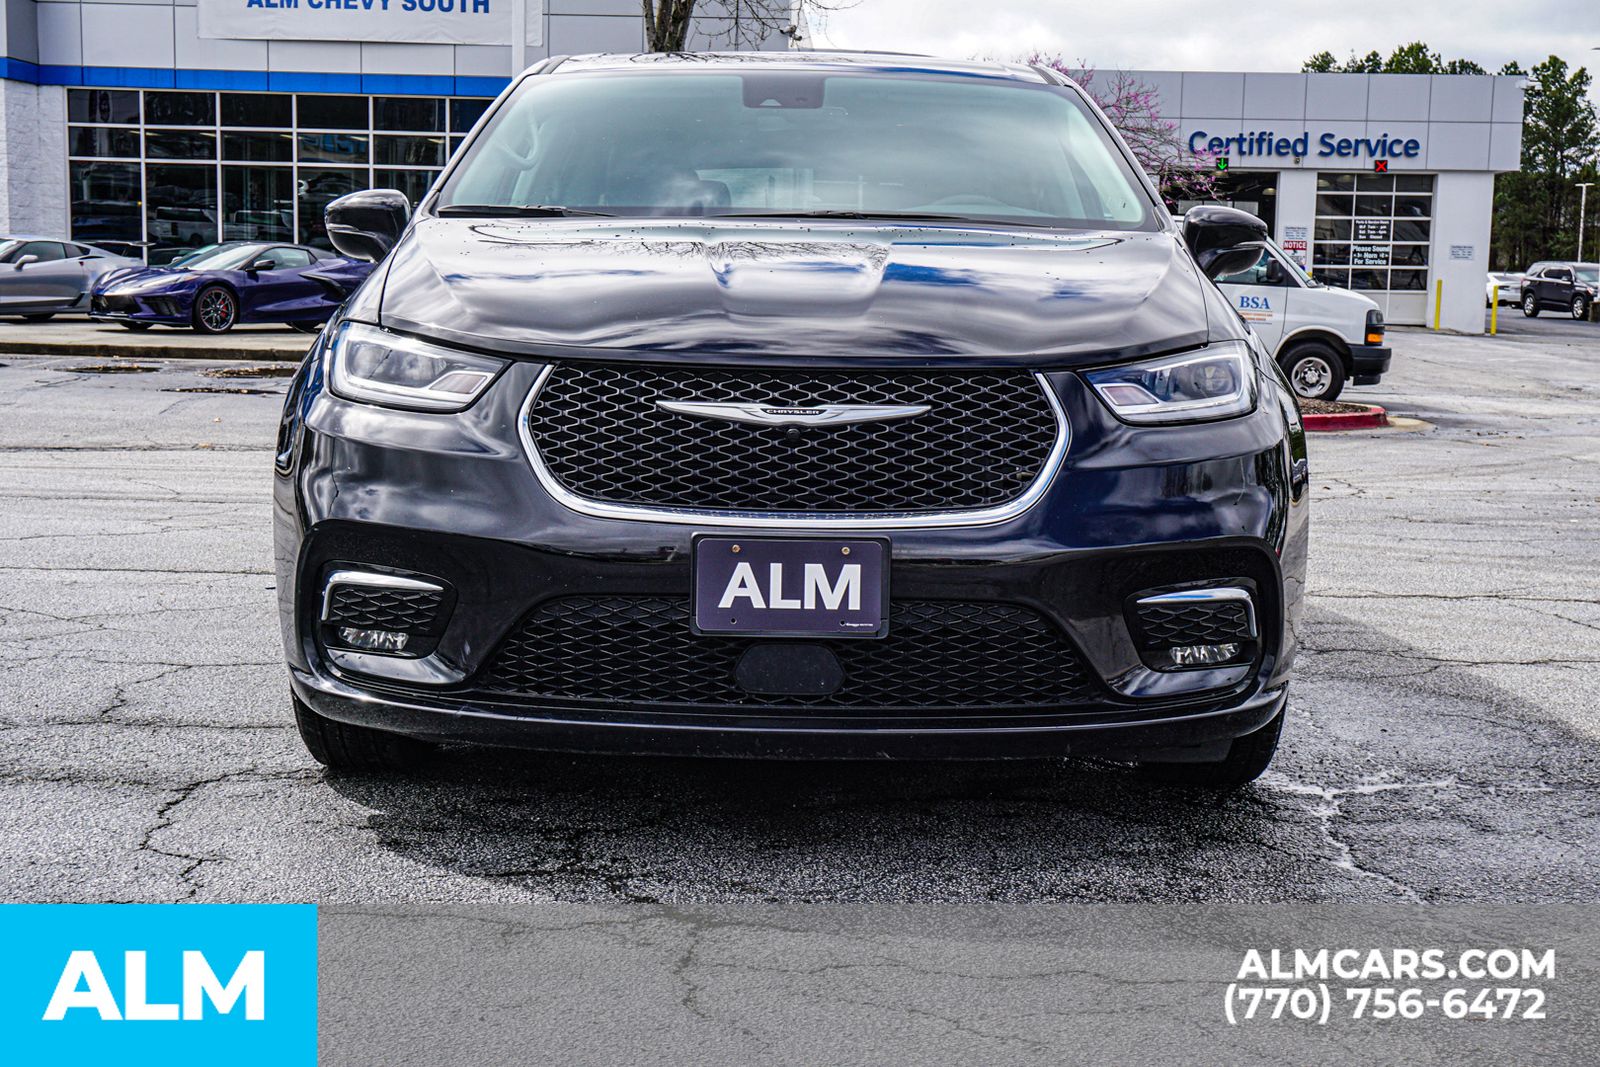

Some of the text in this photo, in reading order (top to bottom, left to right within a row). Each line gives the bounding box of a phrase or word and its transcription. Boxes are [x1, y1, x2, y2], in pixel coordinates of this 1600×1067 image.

[307, 0, 388, 10] CHEVY
[401, 0, 490, 13] SOUTH
[1188, 131, 1420, 157] Certified Service
[1284, 241, 1306, 249] NOTICE
[1240, 296, 1270, 309] BSA
[718, 562, 861, 610] ALM
